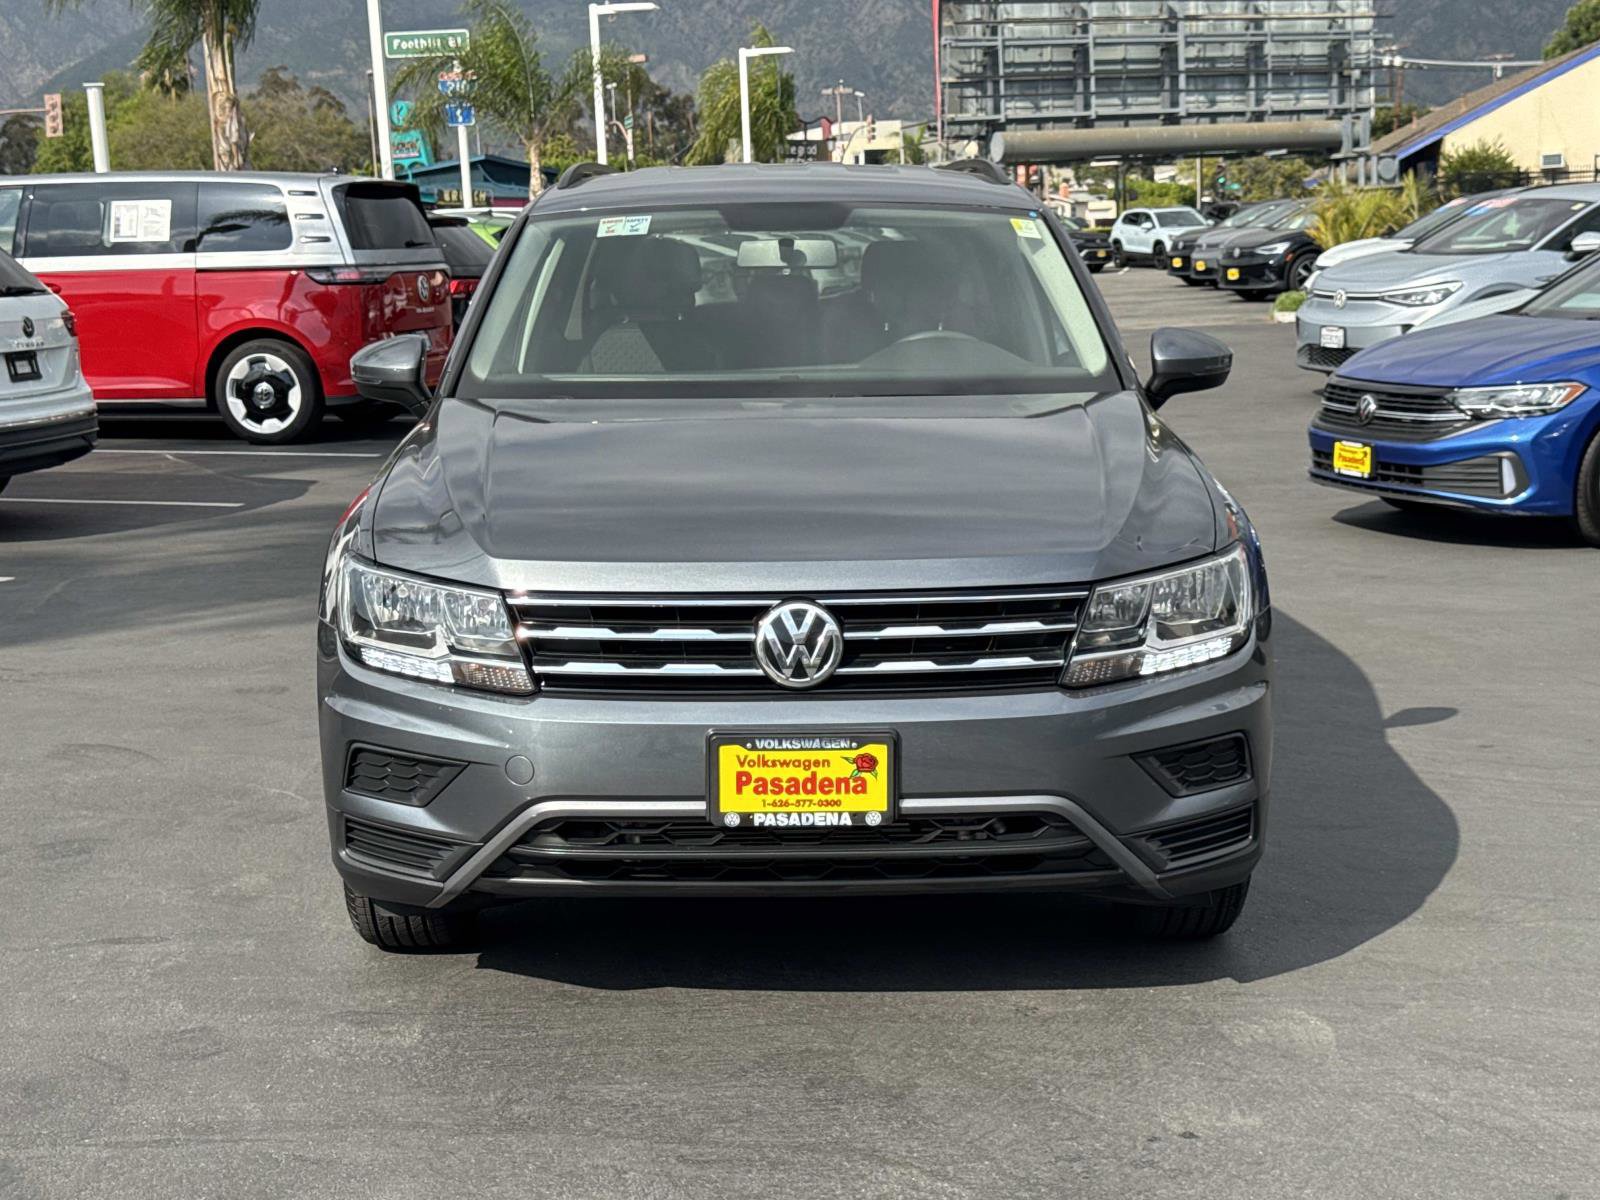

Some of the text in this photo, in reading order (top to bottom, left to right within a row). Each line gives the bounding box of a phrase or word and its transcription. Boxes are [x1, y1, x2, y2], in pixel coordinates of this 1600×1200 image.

[392, 37, 442, 50] Foothill
[755, 738, 851, 749] VOLKSWAGEN
[736, 754, 831, 770] Volkswagen
[735, 771, 868, 795] Pasadena
[761, 798, 842, 808] 1-626-577-0300
[753, 812, 853, 827] PASADENA
